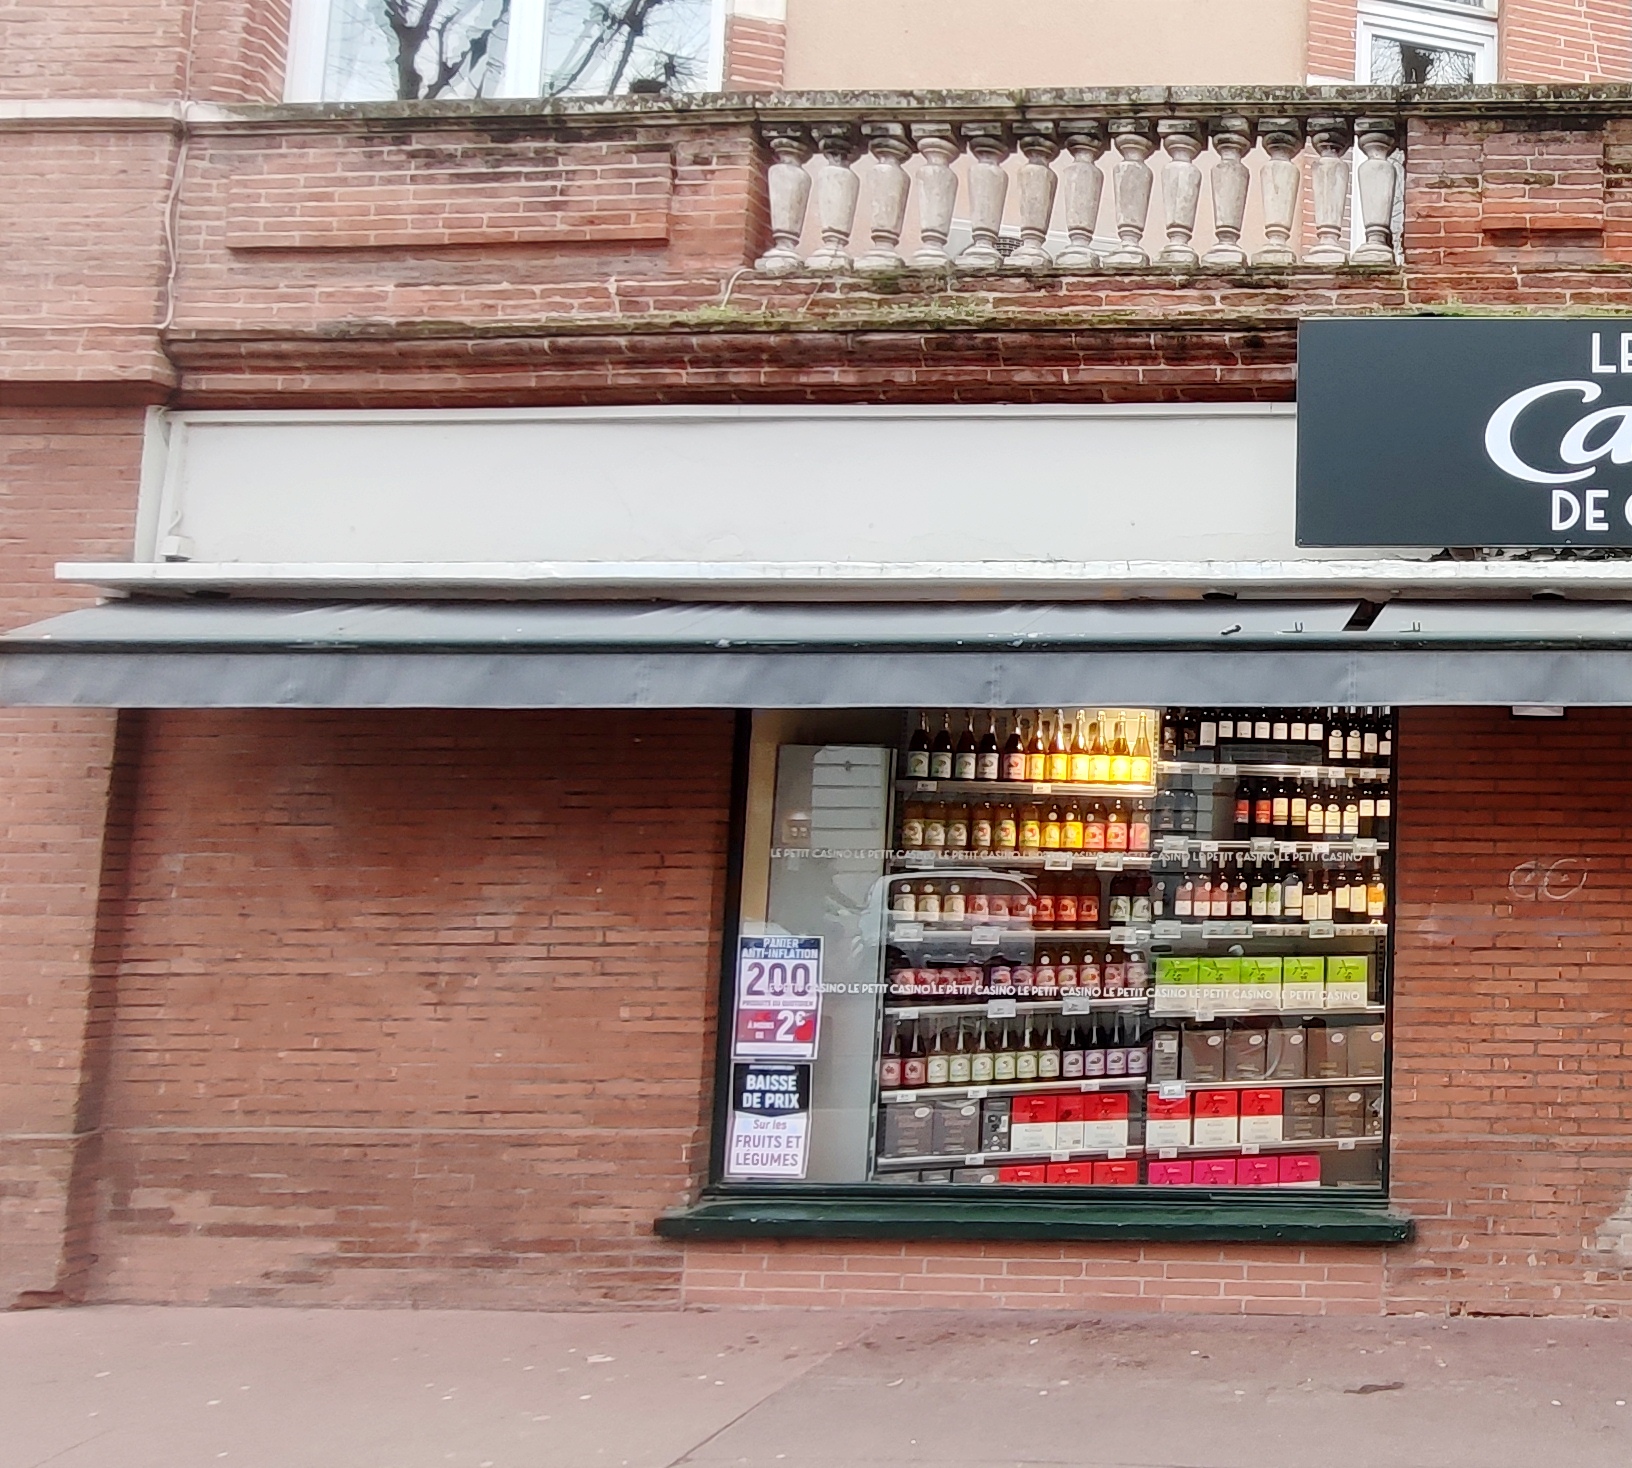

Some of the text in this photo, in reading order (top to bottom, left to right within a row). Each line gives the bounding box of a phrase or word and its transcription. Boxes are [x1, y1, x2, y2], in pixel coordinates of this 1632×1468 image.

[1552, 490, 1608, 530] DE
[771, 849, 782, 858] LE
[784, 849, 809, 858] PETIT
[812, 849, 852, 858] CASINO
[854, 849, 866, 859] LE
[868, 849, 894, 859] PETIT
[1150, 852, 1190, 861] CASINO
[1207, 852, 1235, 861] PETIT
[1236, 852, 1276, 862] CASINO
[1279, 852, 1291, 862] LE
[1293, 852, 1320, 862] PETIT
[1321, 852, 1362, 862] CASINO
[763, 937, 799, 949] PANIER
[742, 948, 818, 959] ANTI-INFLATION
[747, 962, 810, 997] 200
[848, 984, 860, 993] LE
[862, 984, 888, 994] PETIT
[890, 984, 930, 994] CASINO
[932, 984, 944, 994] LE
[945, 984, 973, 995] PETIT
[975, 985, 1015, 995] CASINO
[1018, 986, 1030, 996] LE
[1032, 986, 1058, 996] PETIT
[1060, 986, 1100, 997] CASINO
[1103, 987, 1115, 997] LE
[1117, 987, 1144, 998] PETIT
[1146, 988, 1186, 998] CASINO
[1203, 989, 1231, 999] PETIT
[1232, 989, 1273, 999] CASINO
[1289, 990, 1317, 1000] PETIT
[1319, 990, 1360, 1001] CASINO
[746, 1074, 797, 1091] BAISSE
[743, 1093, 799, 1108] DE PRIX
[753, 1120, 787, 1129] Sur les
[736, 1135, 802, 1149] FRUITS ET
[736, 1148, 799, 1166] LÉGUMES
